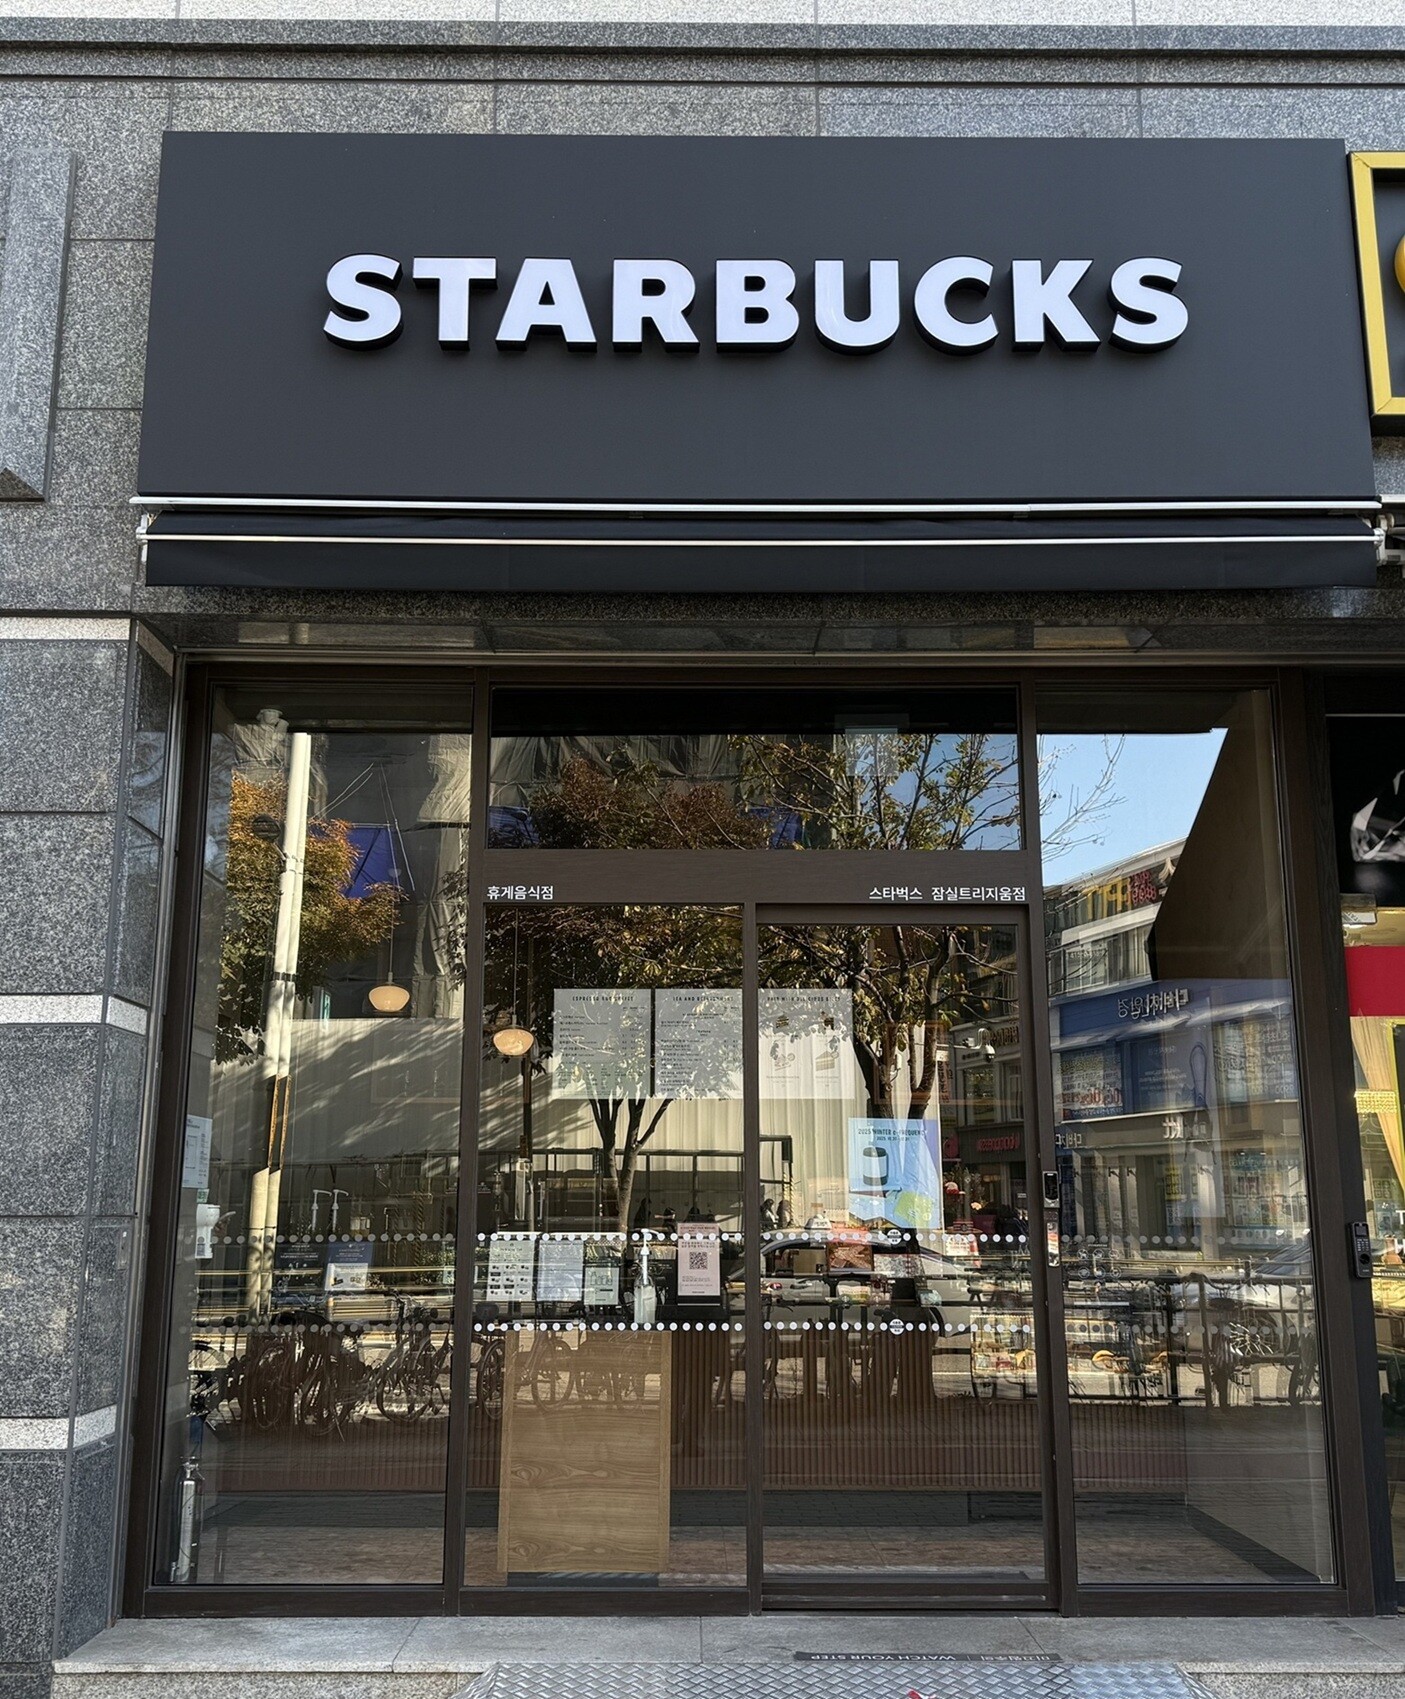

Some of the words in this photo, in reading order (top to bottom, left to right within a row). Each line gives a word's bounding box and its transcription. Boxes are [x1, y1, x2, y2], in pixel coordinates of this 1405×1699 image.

[323, 253, 1190, 349] STARBUCKS
[486, 885, 554, 900] 휴게음식점
[868, 886, 923, 901] 스타벅스
[931, 886, 1026, 901] 잠실트리지움점
[872, 1128, 891, 1136] WINTER
